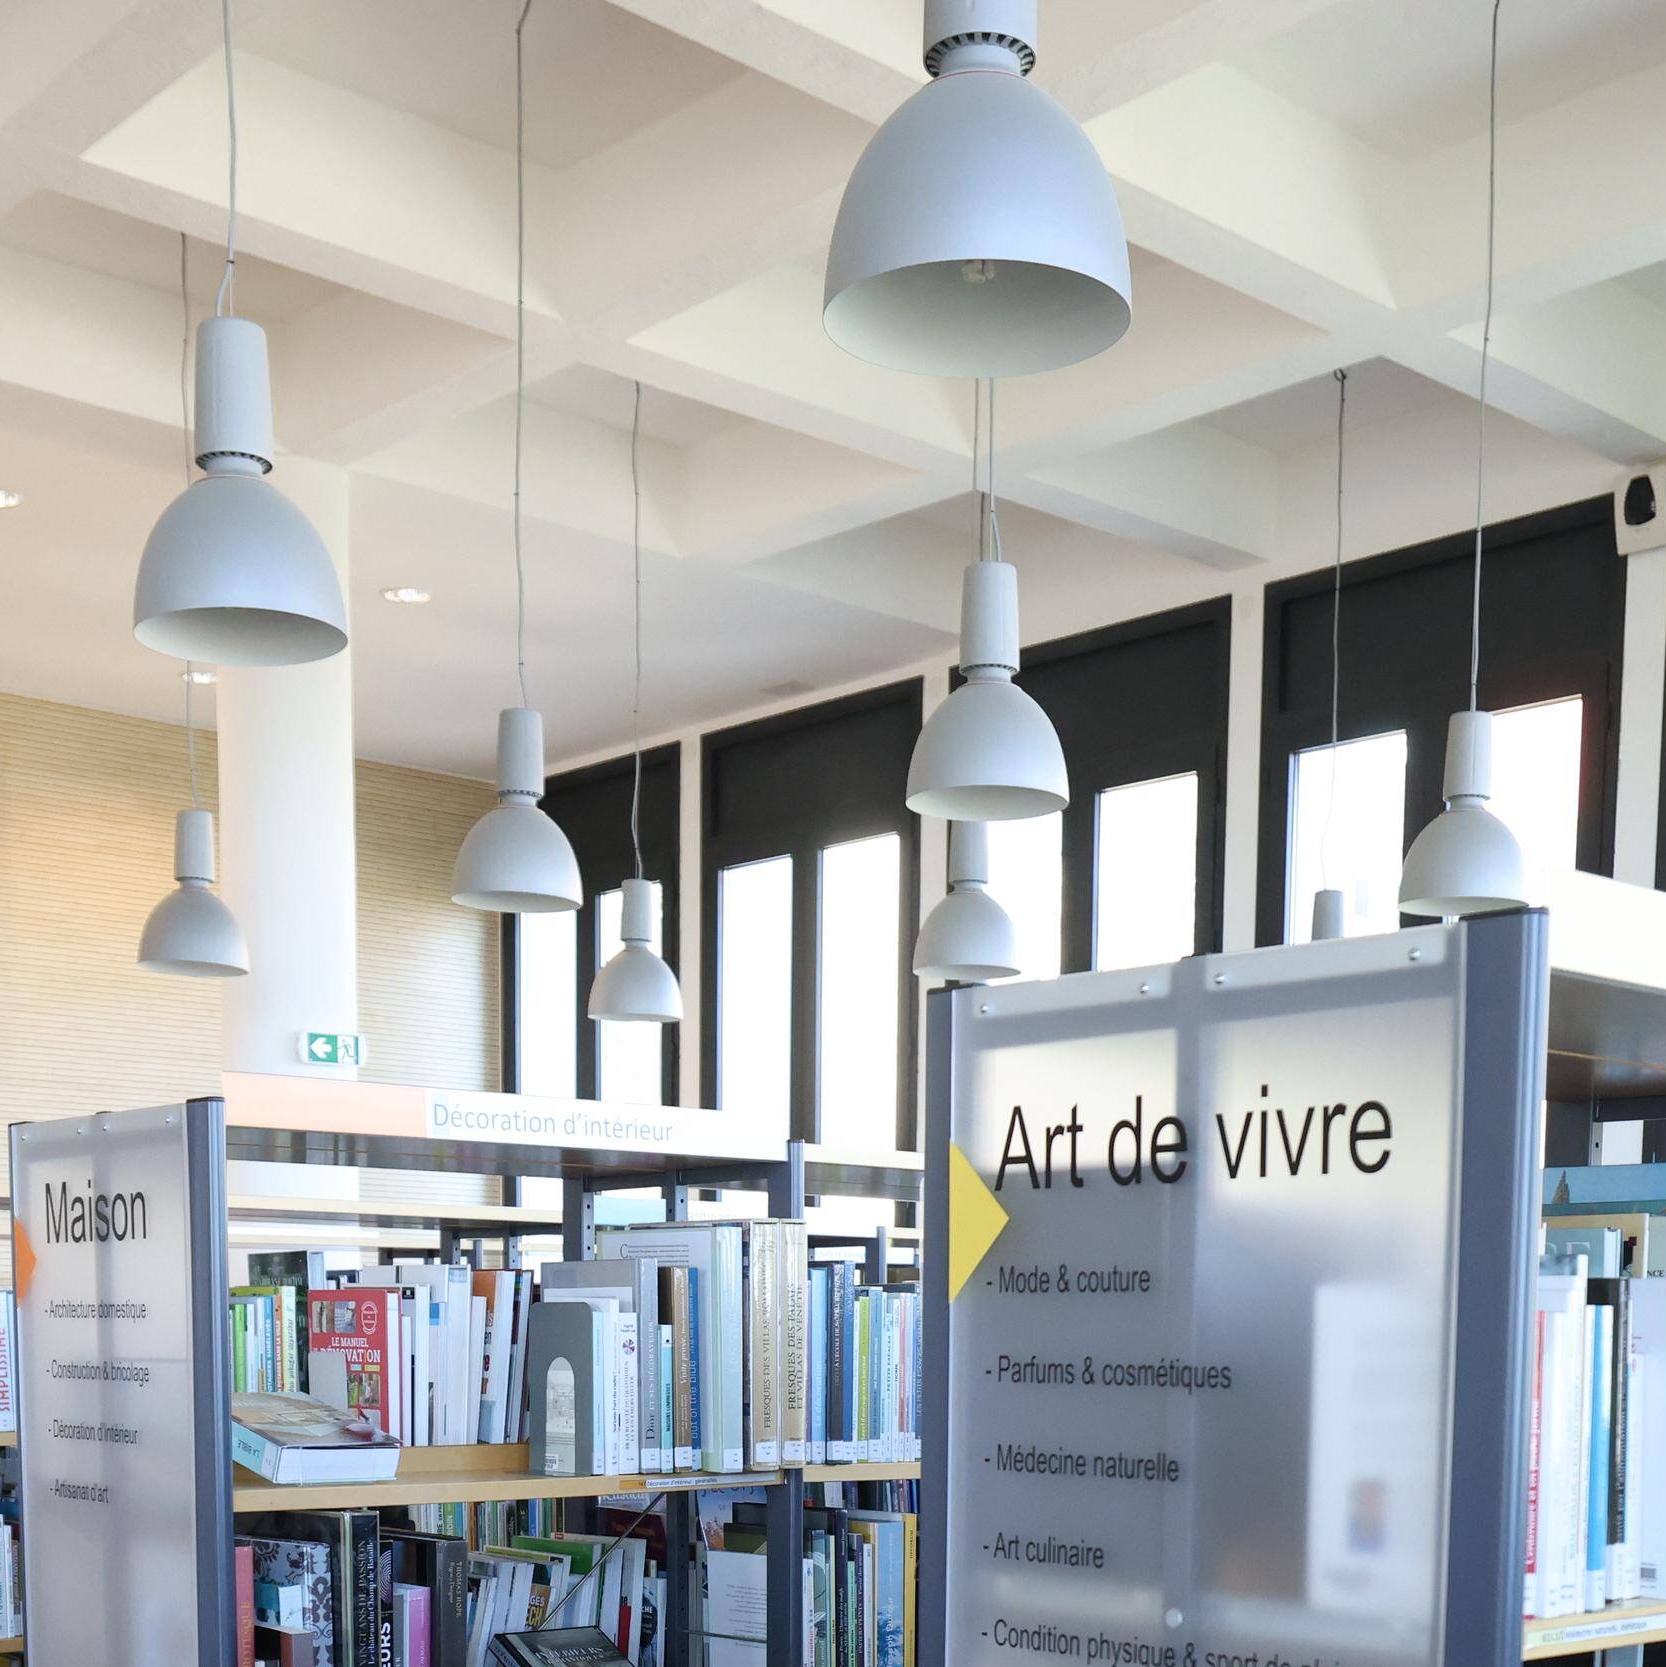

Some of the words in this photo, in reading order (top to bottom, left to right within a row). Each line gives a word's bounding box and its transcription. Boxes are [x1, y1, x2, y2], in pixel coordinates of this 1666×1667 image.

[433, 1103, 557, 1135] Décoration
[994, 1102, 1084, 1192] Art
[1107, 1094, 1189, 1185] de
[1215, 1083, 1394, 1180] vivre
[44, 1180, 147, 1245] Maison
[998, 1265, 1050, 1295] Mode
[1056, 1265, 1071, 1294] &
[1076, 1268, 1151, 1294] couture
[48, 1299, 97, 1320] Architecture
[97, 1300, 147, 1322] domestique
[331, 1336, 339, 1347] LE
[340, 1336, 369, 1348] MANUEL
[762, 1319, 771, 1352] VILLAS
[787, 1325, 796, 1348] DES
[796, 1334, 804, 1350] DE
[50, 1358, 102, 1382] Construction
[102, 1360, 110, 1380] &
[110, 1359, 150, 1385] bricolage
[763, 1356, 771, 1376] DES
[787, 1352, 797, 1410] FRESQUES
[796, 1352, 804, 1390] VILLAS
[997, 1356, 1075, 1387] Parfums
[1081, 1357, 1096, 1386] &
[1101, 1359, 1233, 1397] cosmétiques
[796, 1391, 804, 1409] ET
[814, 1360, 822, 1412] décoration
[763, 1379, 772, 1429] FRESQUES
[52, 1417, 97, 1443] Décoration
[644, 1412, 656, 1440] Dior
[995, 1444, 1088, 1477] Médecine
[1092, 1450, 1180, 1484] naturelle
[53, 1477, 91, 1501] Artisanat
[358, 1539, 367, 1587] PASSION
[366, 1538, 376, 1570] Bataille
[992, 1532, 1020, 1563] Art
[1024, 1536, 1105, 1570] culinaire
[366, 1571, 376, 1581] de
[455, 1560, 463, 1595] THOMAS
[358, 1591, 367, 1609] DE
[367, 1582, 377, 1610] Champ
[358, 1611, 367, 1634] ANS
[366, 1610, 376, 1621] du
[885, 1596, 895, 1632] Dufour
[358, 1635, 367, 1666] VINGT
[366, 1623, 376, 1653] château
[992, 1618, 1081, 1656] Condition
[366, 1654, 376, 1665] Le
